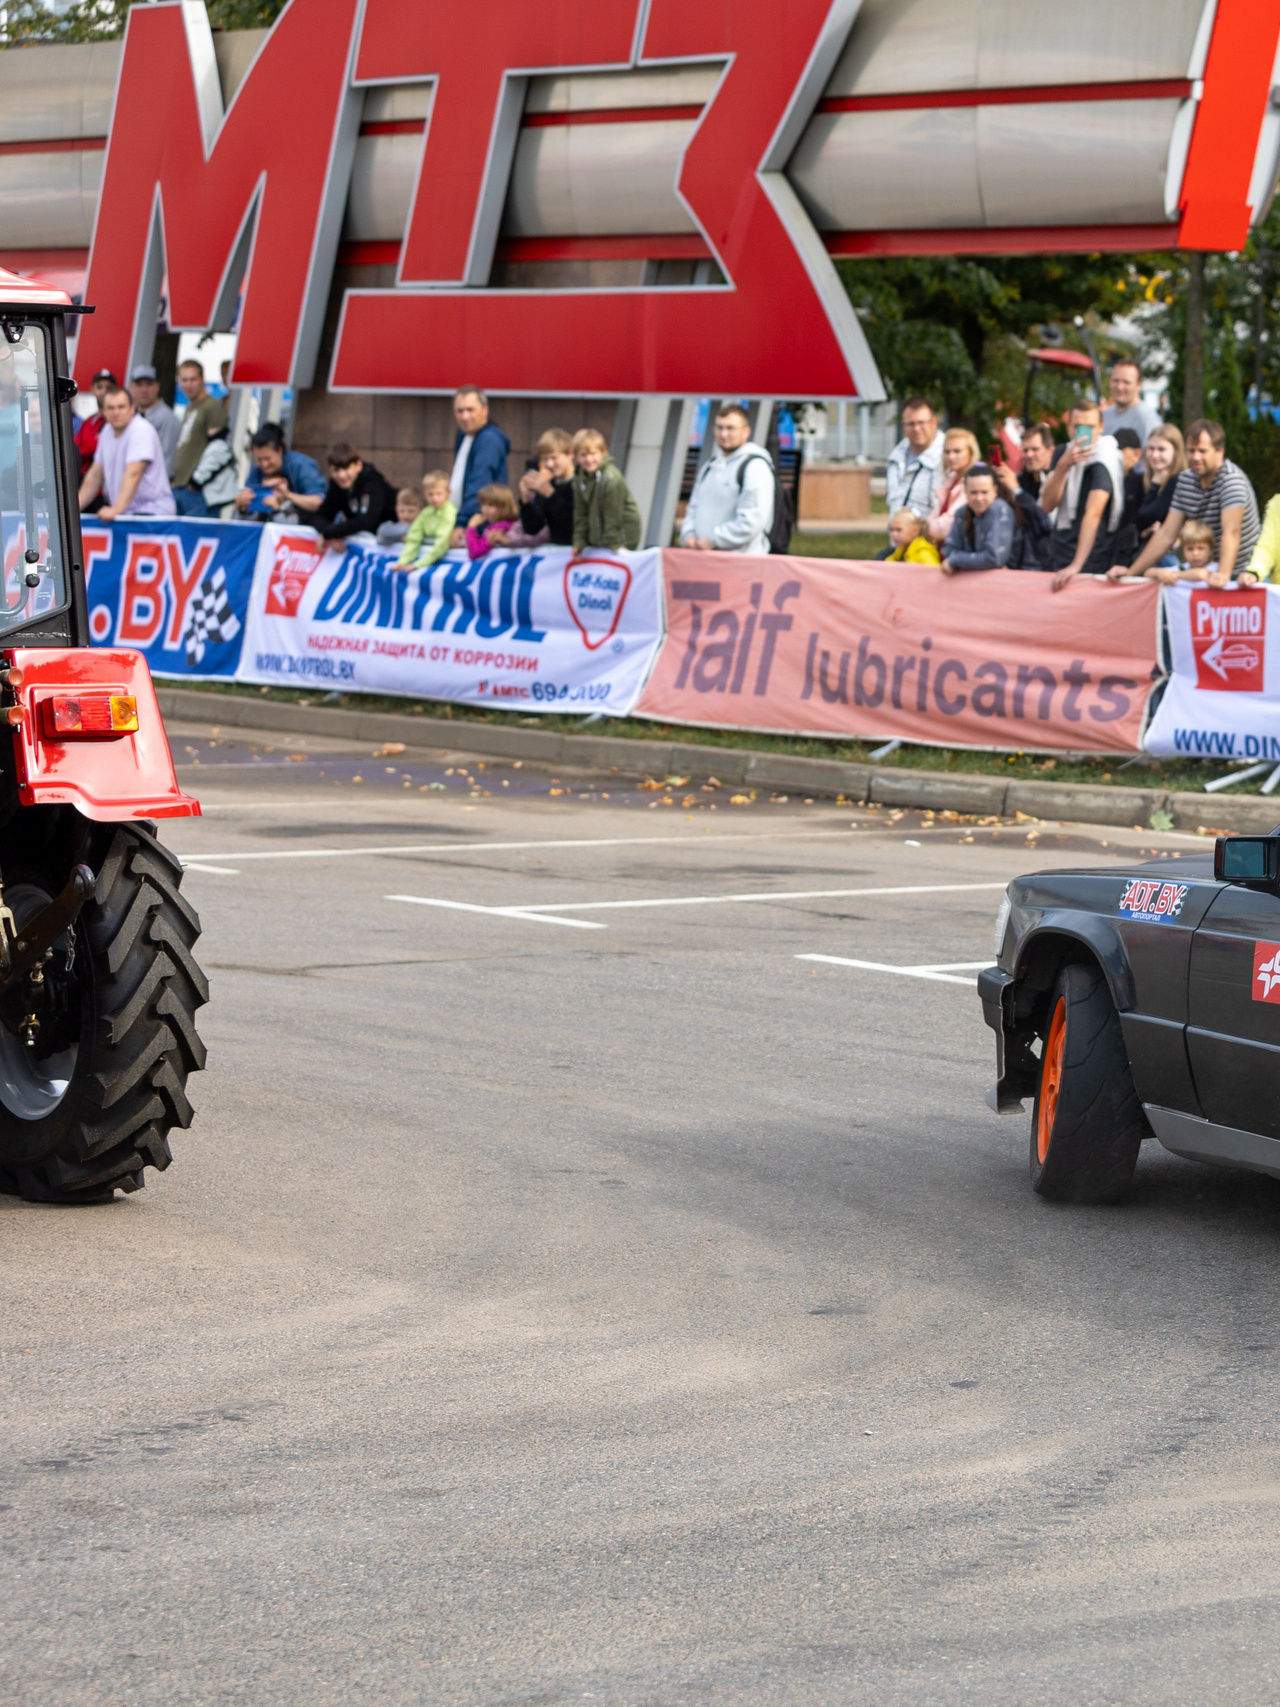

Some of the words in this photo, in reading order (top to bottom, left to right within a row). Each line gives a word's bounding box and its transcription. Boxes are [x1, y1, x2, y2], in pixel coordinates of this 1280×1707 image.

[313, 543, 547, 643] DINITROL
[578, 593, 612, 612] Dinol
[1196, 600, 1262, 640] Pyrmo
[308, 635, 370, 656] НАДЕЖНАЯ
[372, 640, 426, 660] ЗАЩИТА
[430, 646, 449, 662] ОТ
[453, 649, 539, 672] КОРРОЗИИ
[671, 580, 801, 697] Taif
[800, 632, 1138, 723] lubricants
